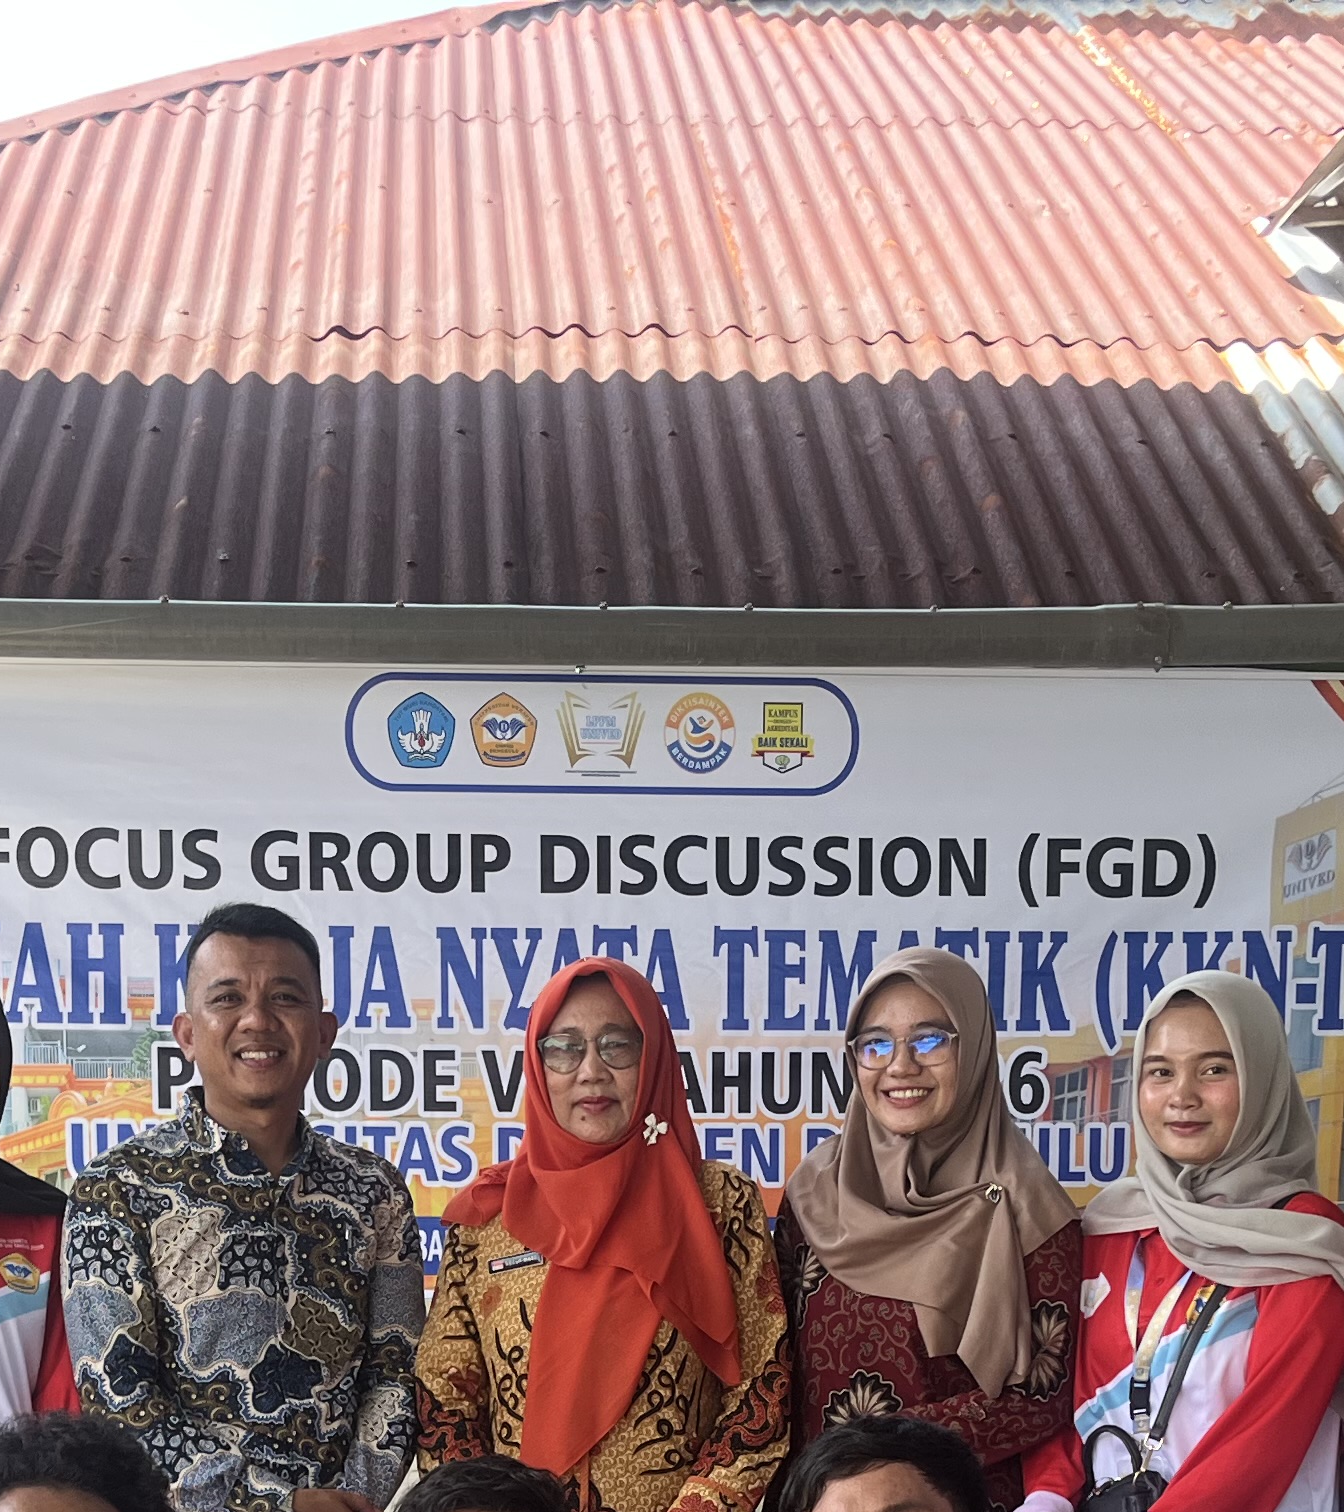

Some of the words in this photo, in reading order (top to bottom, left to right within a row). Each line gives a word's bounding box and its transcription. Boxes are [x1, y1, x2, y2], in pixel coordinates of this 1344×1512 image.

[768, 709, 799, 719] KAMPUS
[670, 745, 729, 771] BERDAMPAK
[758, 737, 778, 748] BAIK
[779, 738, 808, 749] SEKALI
[251, 830, 511, 894] GROUP
[540, 834, 986, 897] DISCUSSION
[1018, 833, 1216, 908] (FGD)
[154, 923, 411, 1029] KJA
[157, 1047, 456, 1112] PODE
[677, 1052, 854, 1114] AHUN
